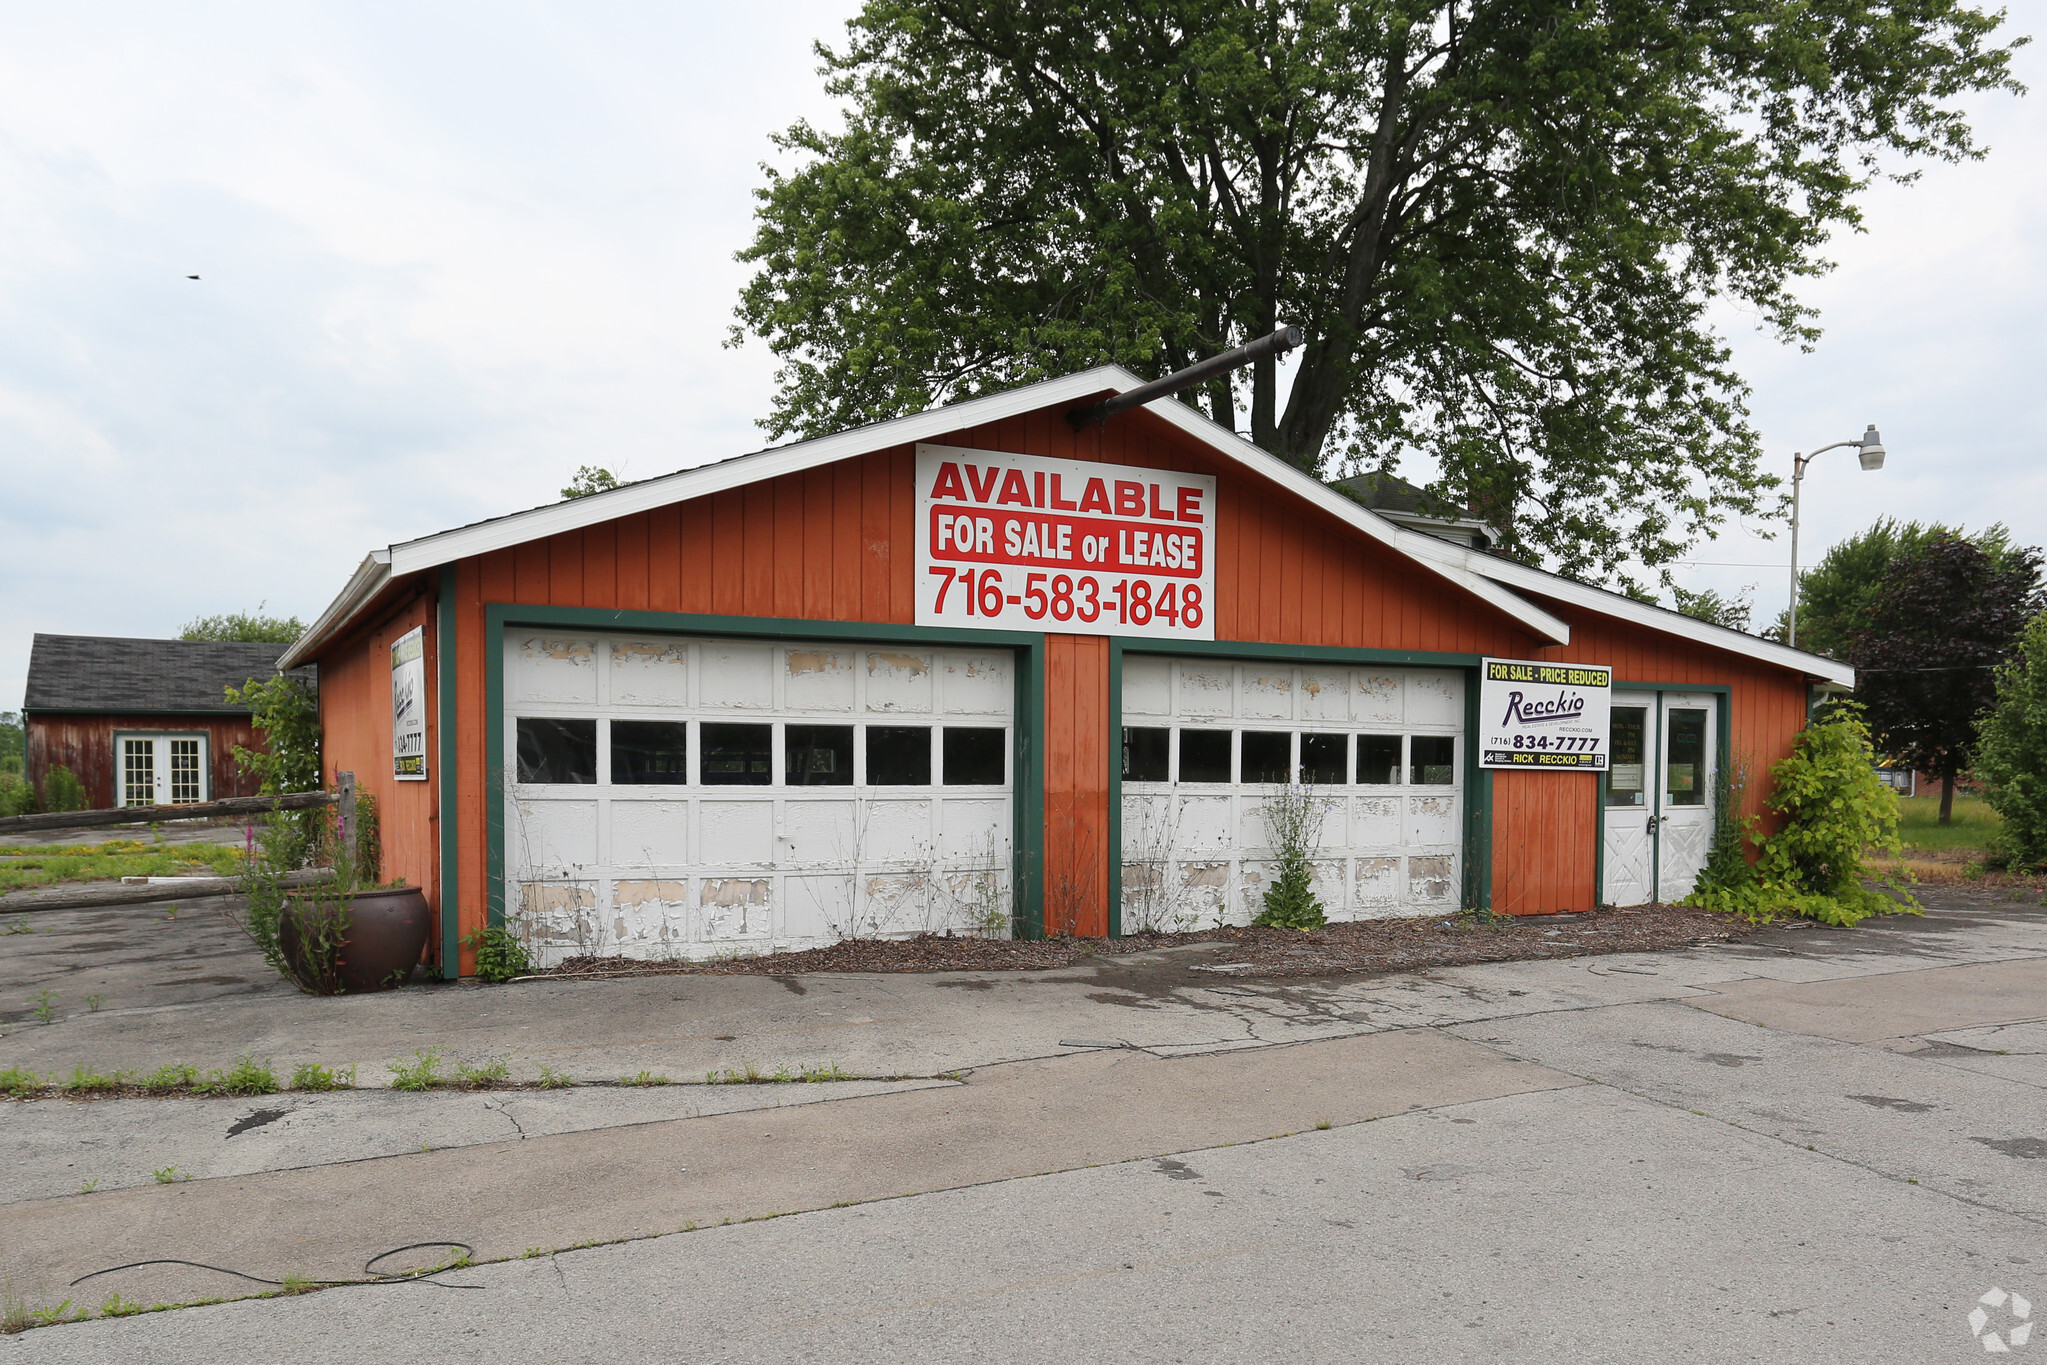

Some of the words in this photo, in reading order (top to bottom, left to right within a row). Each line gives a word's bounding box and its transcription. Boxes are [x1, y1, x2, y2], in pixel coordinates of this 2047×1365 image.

[931, 462, 1204, 523] AVAILABLE
[938, 514, 994, 554] FOR
[1004, 519, 1072, 560] SALE
[1082, 534, 1109, 563] or
[1119, 530, 1196, 570] LEASE
[929, 566, 1204, 629] 716-583-1848
[1490, 664, 1509, 680] FOR
[1510, 665, 1533, 681] SALE
[1540, 668, 1567, 683] PRICE
[1568, 670, 1608, 686] REDUCED
[1502, 690, 1584, 727] Recckio
[1490, 736, 1511, 746] (716)
[1513, 735, 1600, 752] 834-7777
[1513, 754, 1535, 763] RICK
[1539, 755, 1577, 765] RECCKIO
